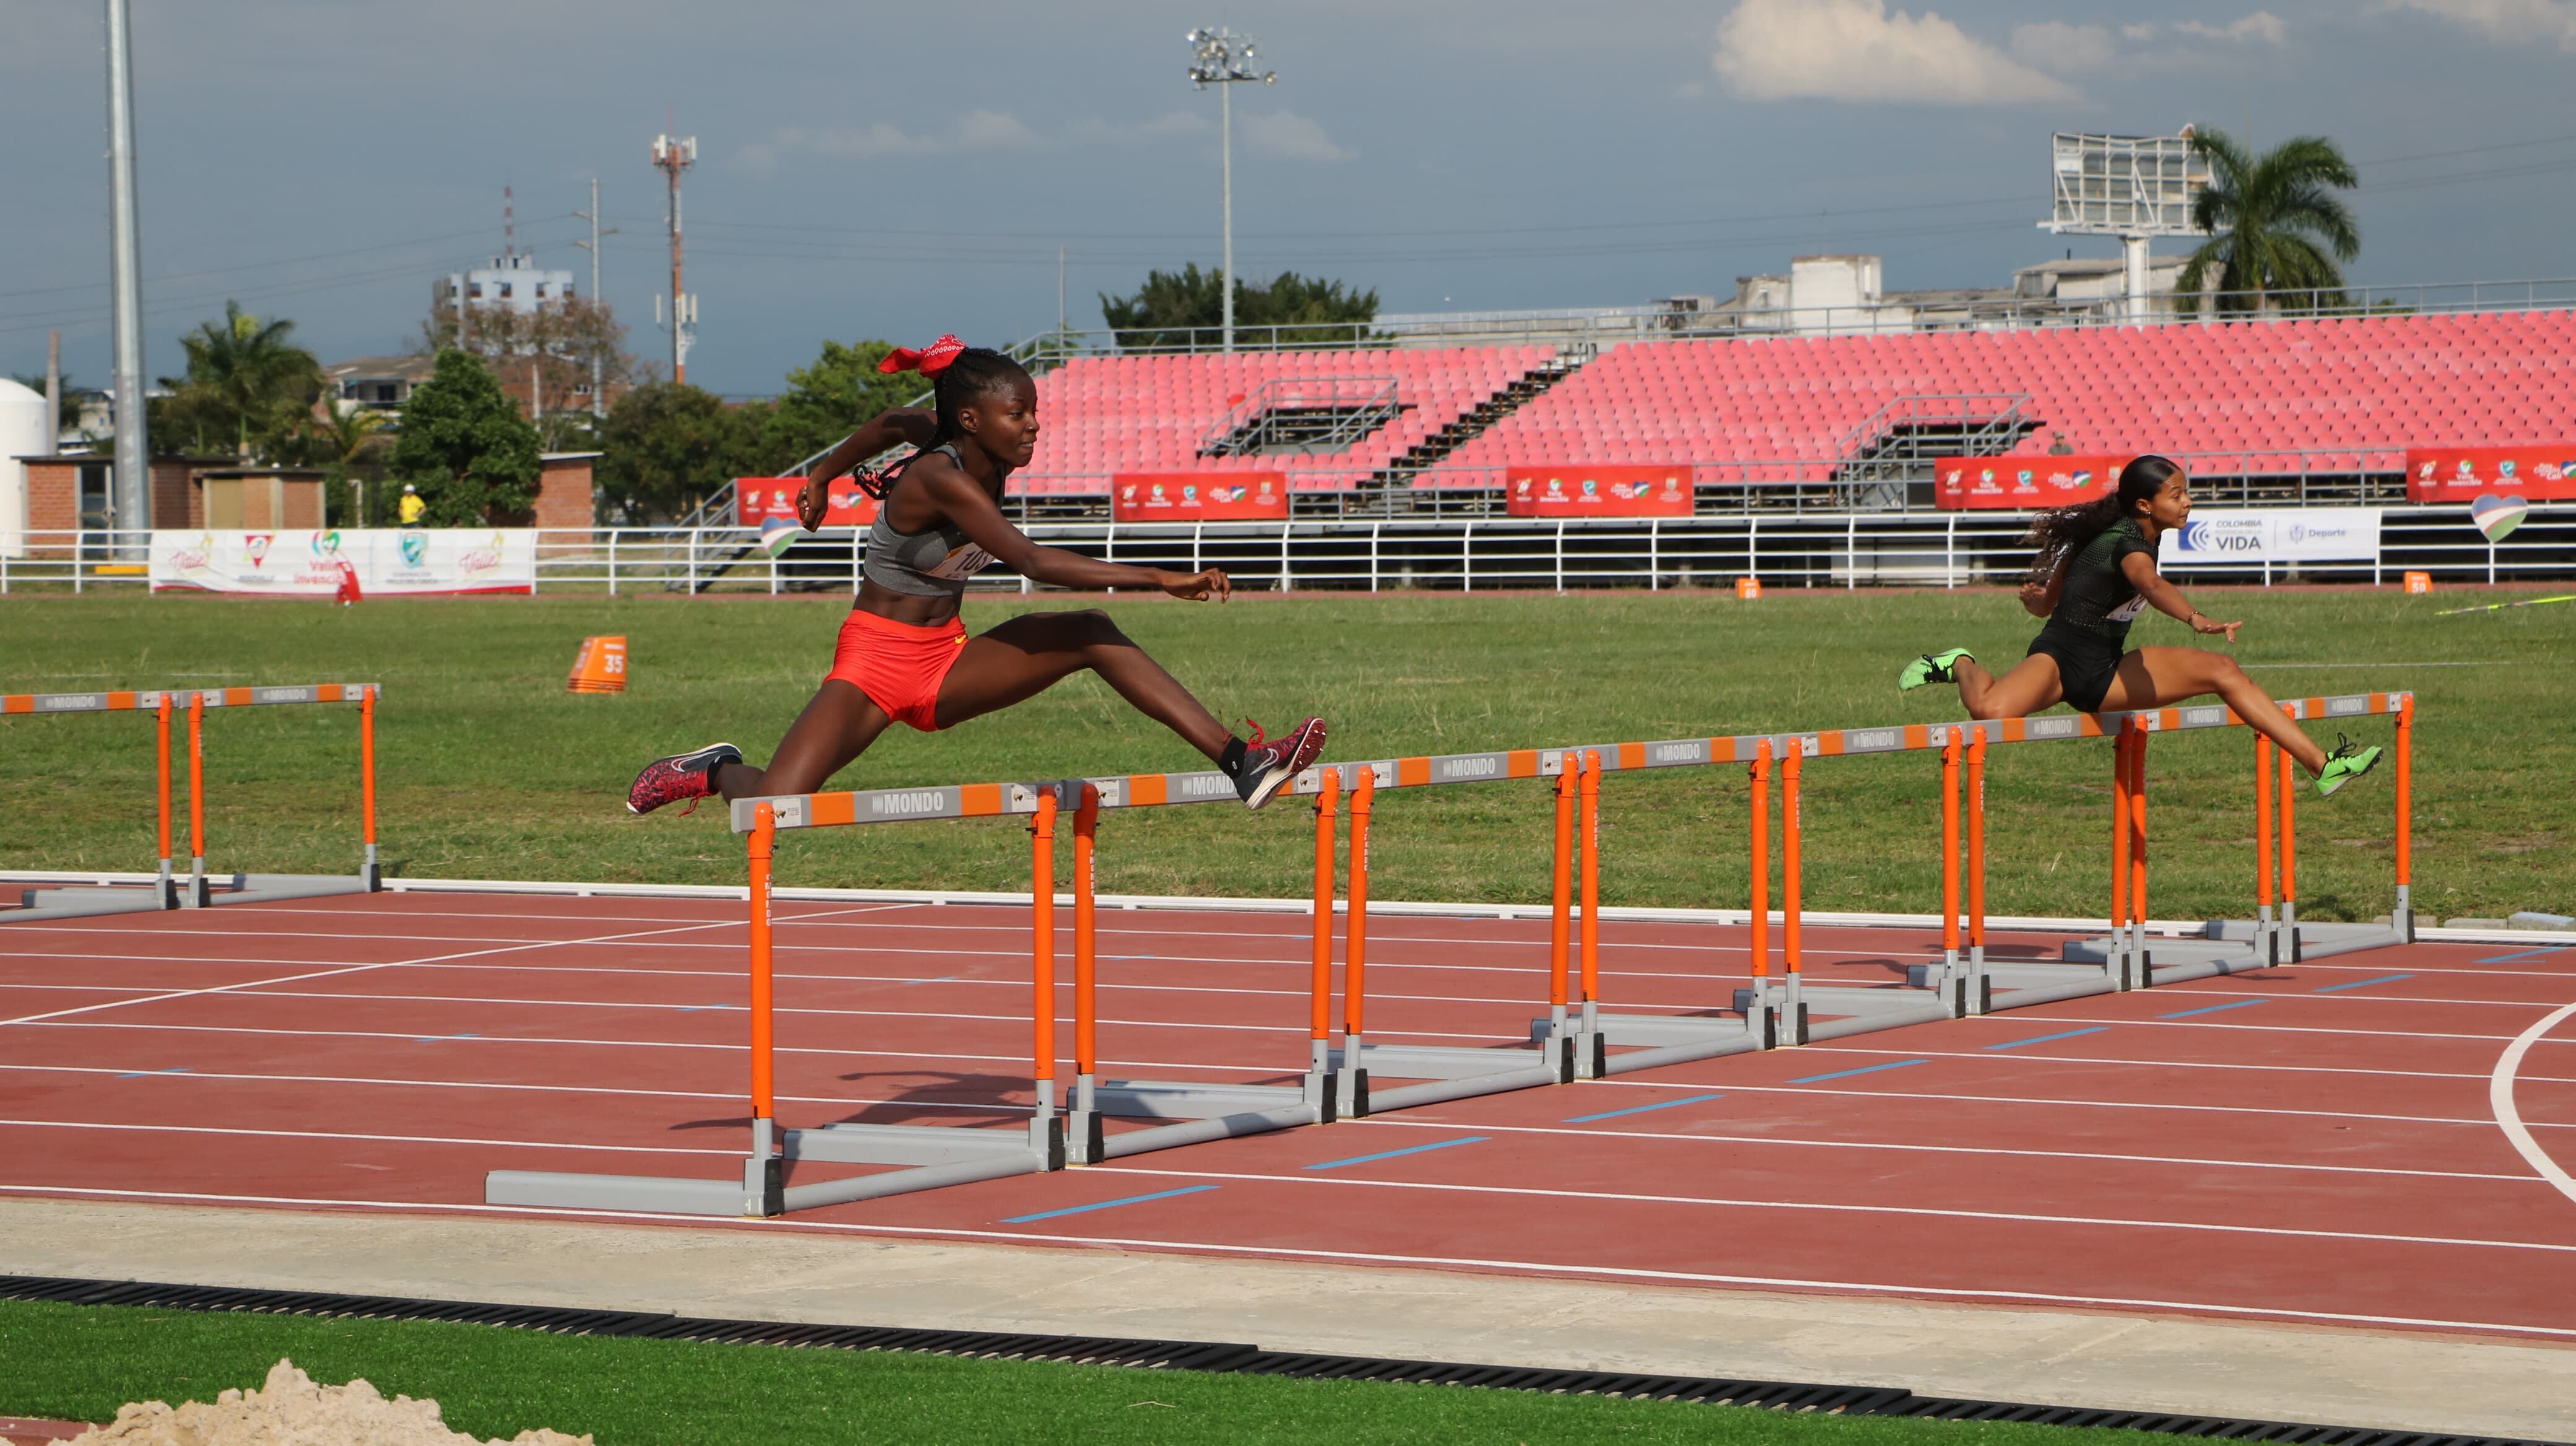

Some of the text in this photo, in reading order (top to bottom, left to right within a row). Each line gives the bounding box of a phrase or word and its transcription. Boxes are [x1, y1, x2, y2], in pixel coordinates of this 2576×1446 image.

[2216, 520, 2263, 528] COLOMBIA
[2309, 528, 2347, 538] Deporte
[2216, 536, 2262, 550] VIDA
[604, 654, 624, 673] 35
[54, 695, 95, 708] MONDO
[269, 689, 308, 701] MONDO
[2337, 698, 2362, 712] MONDO
[2192, 708, 2220, 724] MONDO
[2041, 719, 2073, 735] MONDO
[1860, 731, 1894, 748] MONDO
[1663, 743, 1700, 761] MONDO
[1452, 757, 1495, 777] MONDO
[1193, 775, 1237, 795] MOND
[884, 791, 944, 814] MONDO
